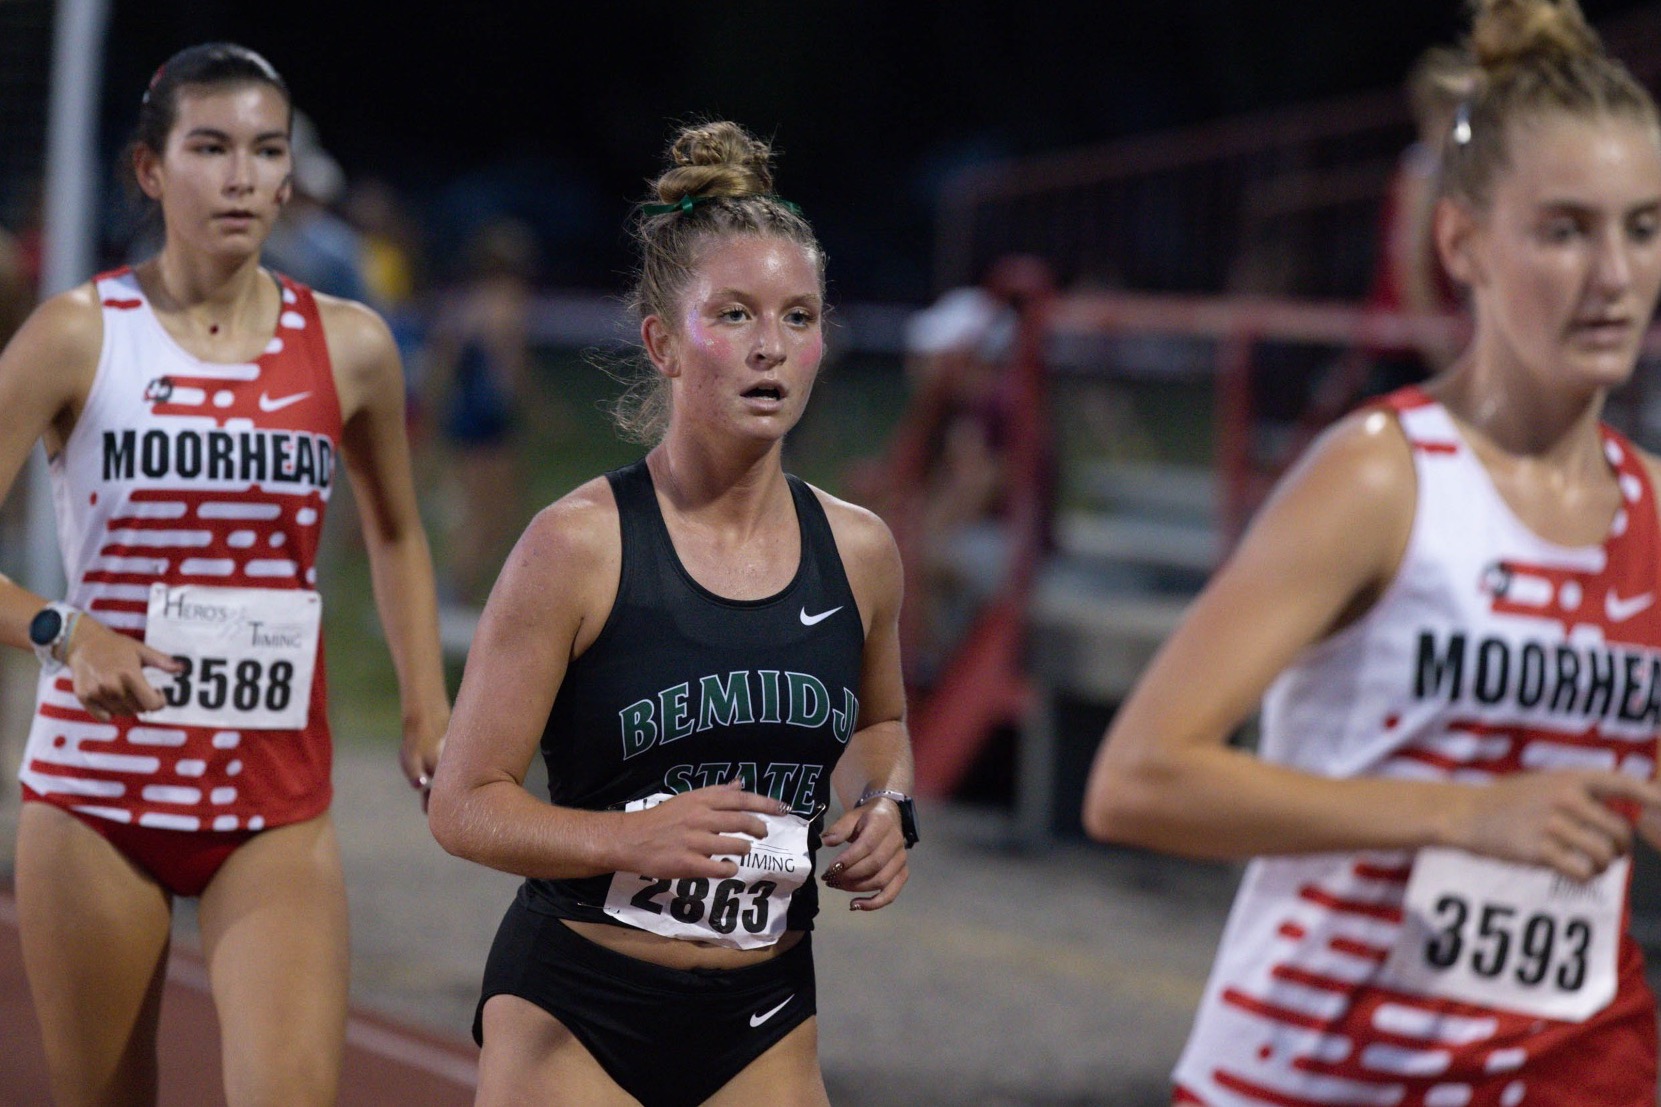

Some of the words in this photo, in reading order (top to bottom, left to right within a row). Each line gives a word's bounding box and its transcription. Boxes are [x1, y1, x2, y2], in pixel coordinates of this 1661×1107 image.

[103, 430, 331, 488] MOORHEAD
[163, 655, 293, 711] 3588
[619, 670, 859, 760] BEMIDJ
[1413, 631, 1661, 726] MOORHEA
[630, 876, 777, 934] 2863
[1425, 895, 1591, 992] 3593
